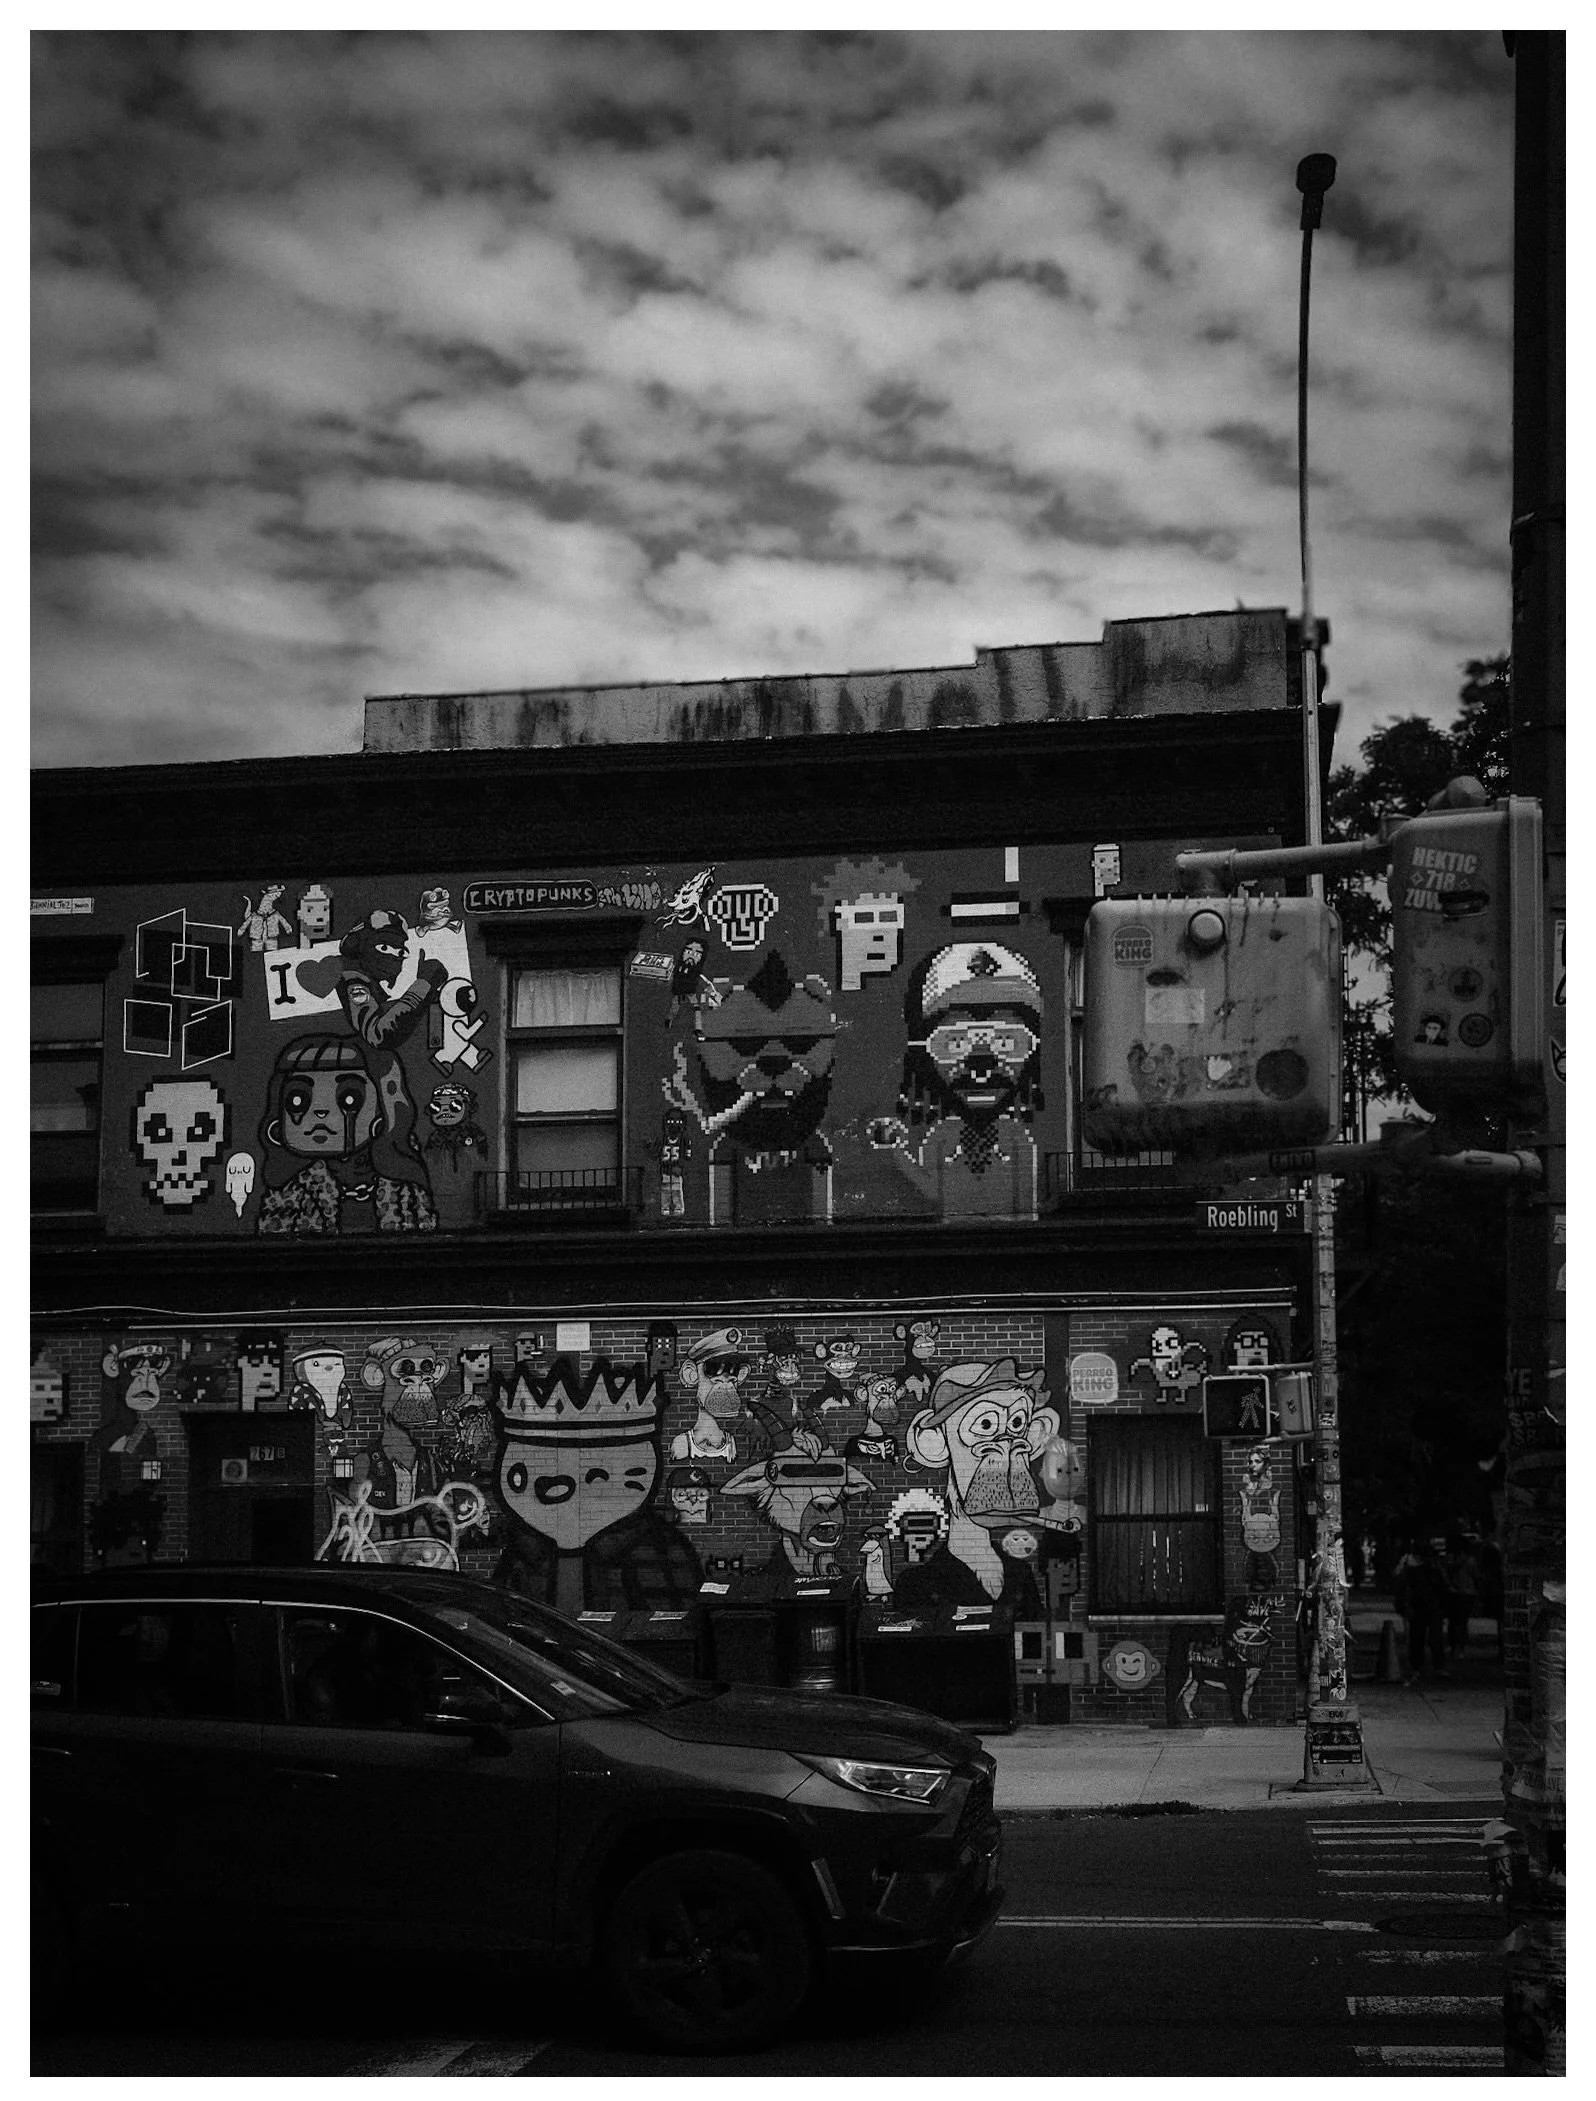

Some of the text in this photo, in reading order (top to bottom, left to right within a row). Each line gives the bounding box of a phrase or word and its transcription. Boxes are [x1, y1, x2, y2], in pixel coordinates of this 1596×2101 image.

[1412, 846, 1477, 874] HEKTIC
[1425, 869, 1456, 891] 718
[469, 886, 594, 907] CRYPTOPUNKS
[1115, 948, 1152, 959] KING
[663, 1146, 680, 1161] 55
[1207, 1203, 1298, 1232] Roebling St
[1073, 1378, 1113, 1392] KING
